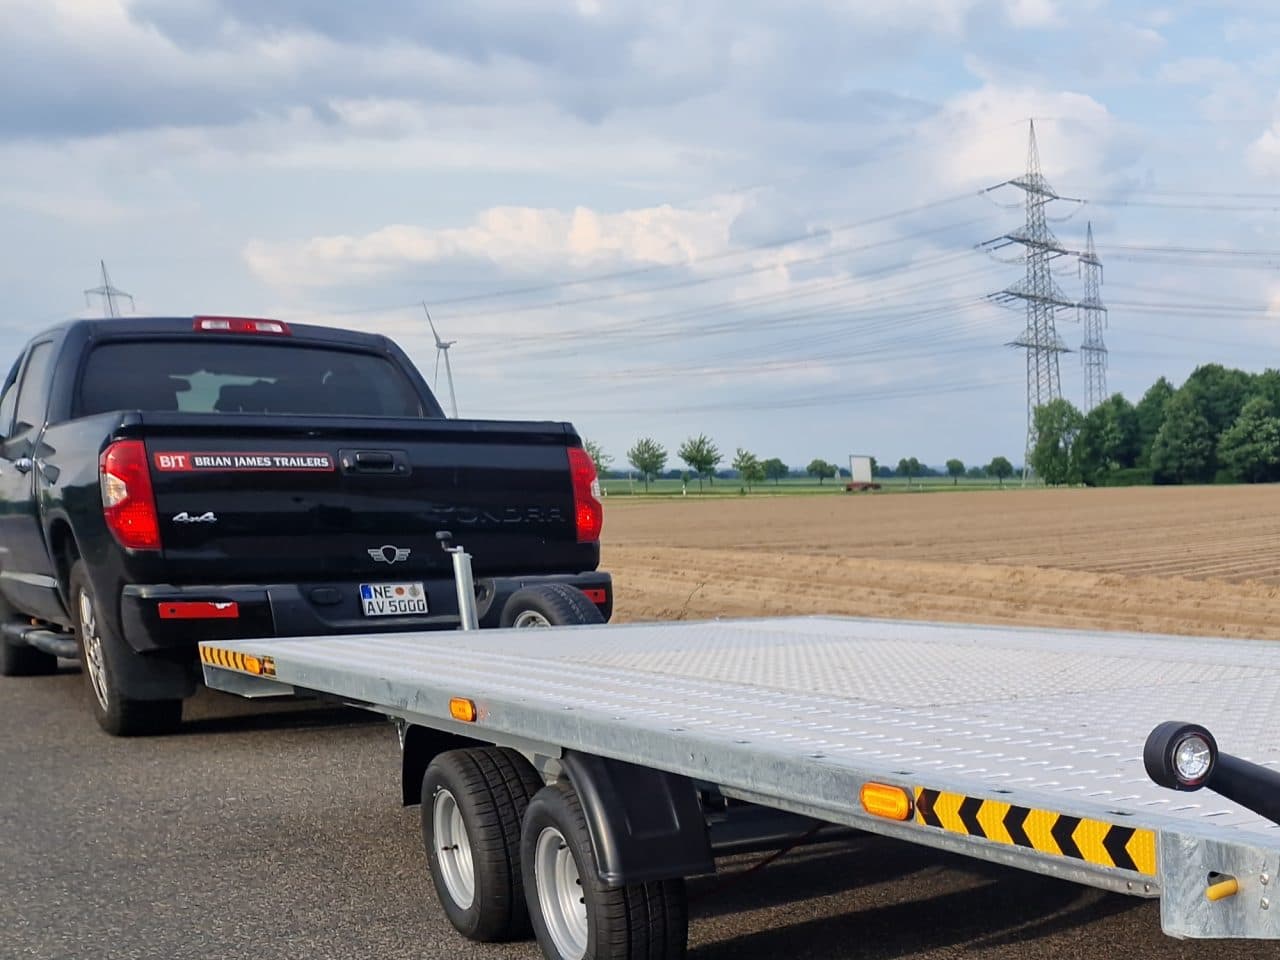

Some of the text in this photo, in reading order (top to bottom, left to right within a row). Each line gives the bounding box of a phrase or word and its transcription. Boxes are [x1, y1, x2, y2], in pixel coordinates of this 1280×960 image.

[159, 455, 186, 468] BJT
[194, 456, 329, 468] BRIAN JAMES TRAILERS
[373, 585, 394, 599] NE
[367, 599, 426, 614] AV 5000
